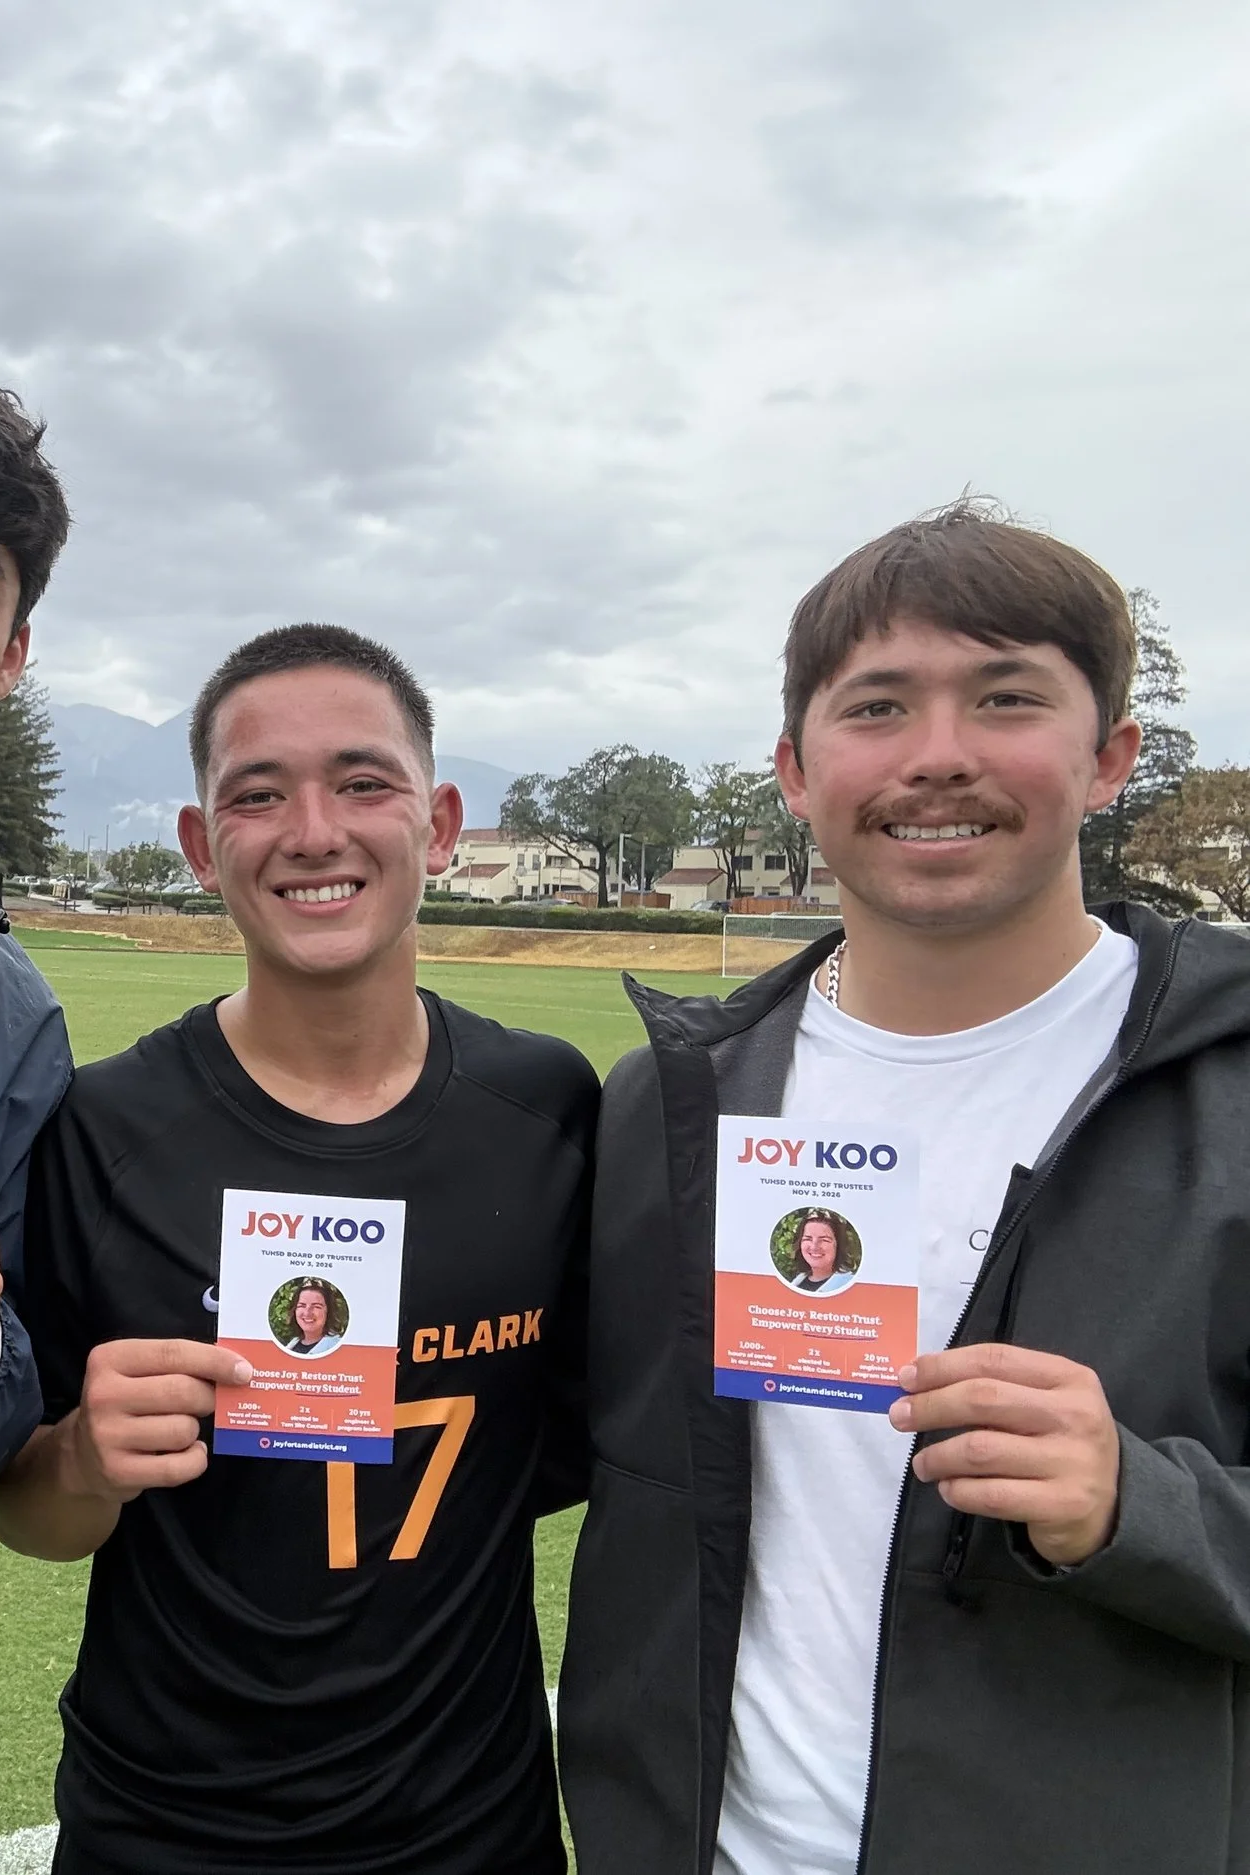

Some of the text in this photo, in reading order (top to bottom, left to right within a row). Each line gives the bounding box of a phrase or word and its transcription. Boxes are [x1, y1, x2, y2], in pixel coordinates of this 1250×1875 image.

[738, 1137, 898, 1171] JOY KOO
[760, 1178, 786, 1186] TUHSD
[788, 1179, 818, 1188] BOARD
[833, 1183, 873, 1191] TRUSTEES
[241, 1211, 385, 1244] JOY KOO
[286, 1251, 313, 1259] BOARD
[326, 1254, 363, 1262] TRUSTEES
[748, 1305, 883, 1325] Choose Joy. Restore Trust.
[751, 1317, 878, 1338] Empower Every Student.
[412, 1308, 544, 1363] CLARK
[753, 1352, 777, 1361] service
[876, 1355, 889, 1363] yrs
[252, 1369, 365, 1383] hoose Joy. Restore Trust.
[250, 1380, 361, 1394] Empower Every Student.
[779, 1383, 863, 1401] joyfortamdistrict.org
[273, 1440, 347, 1452] joyfortamdistrict.org
